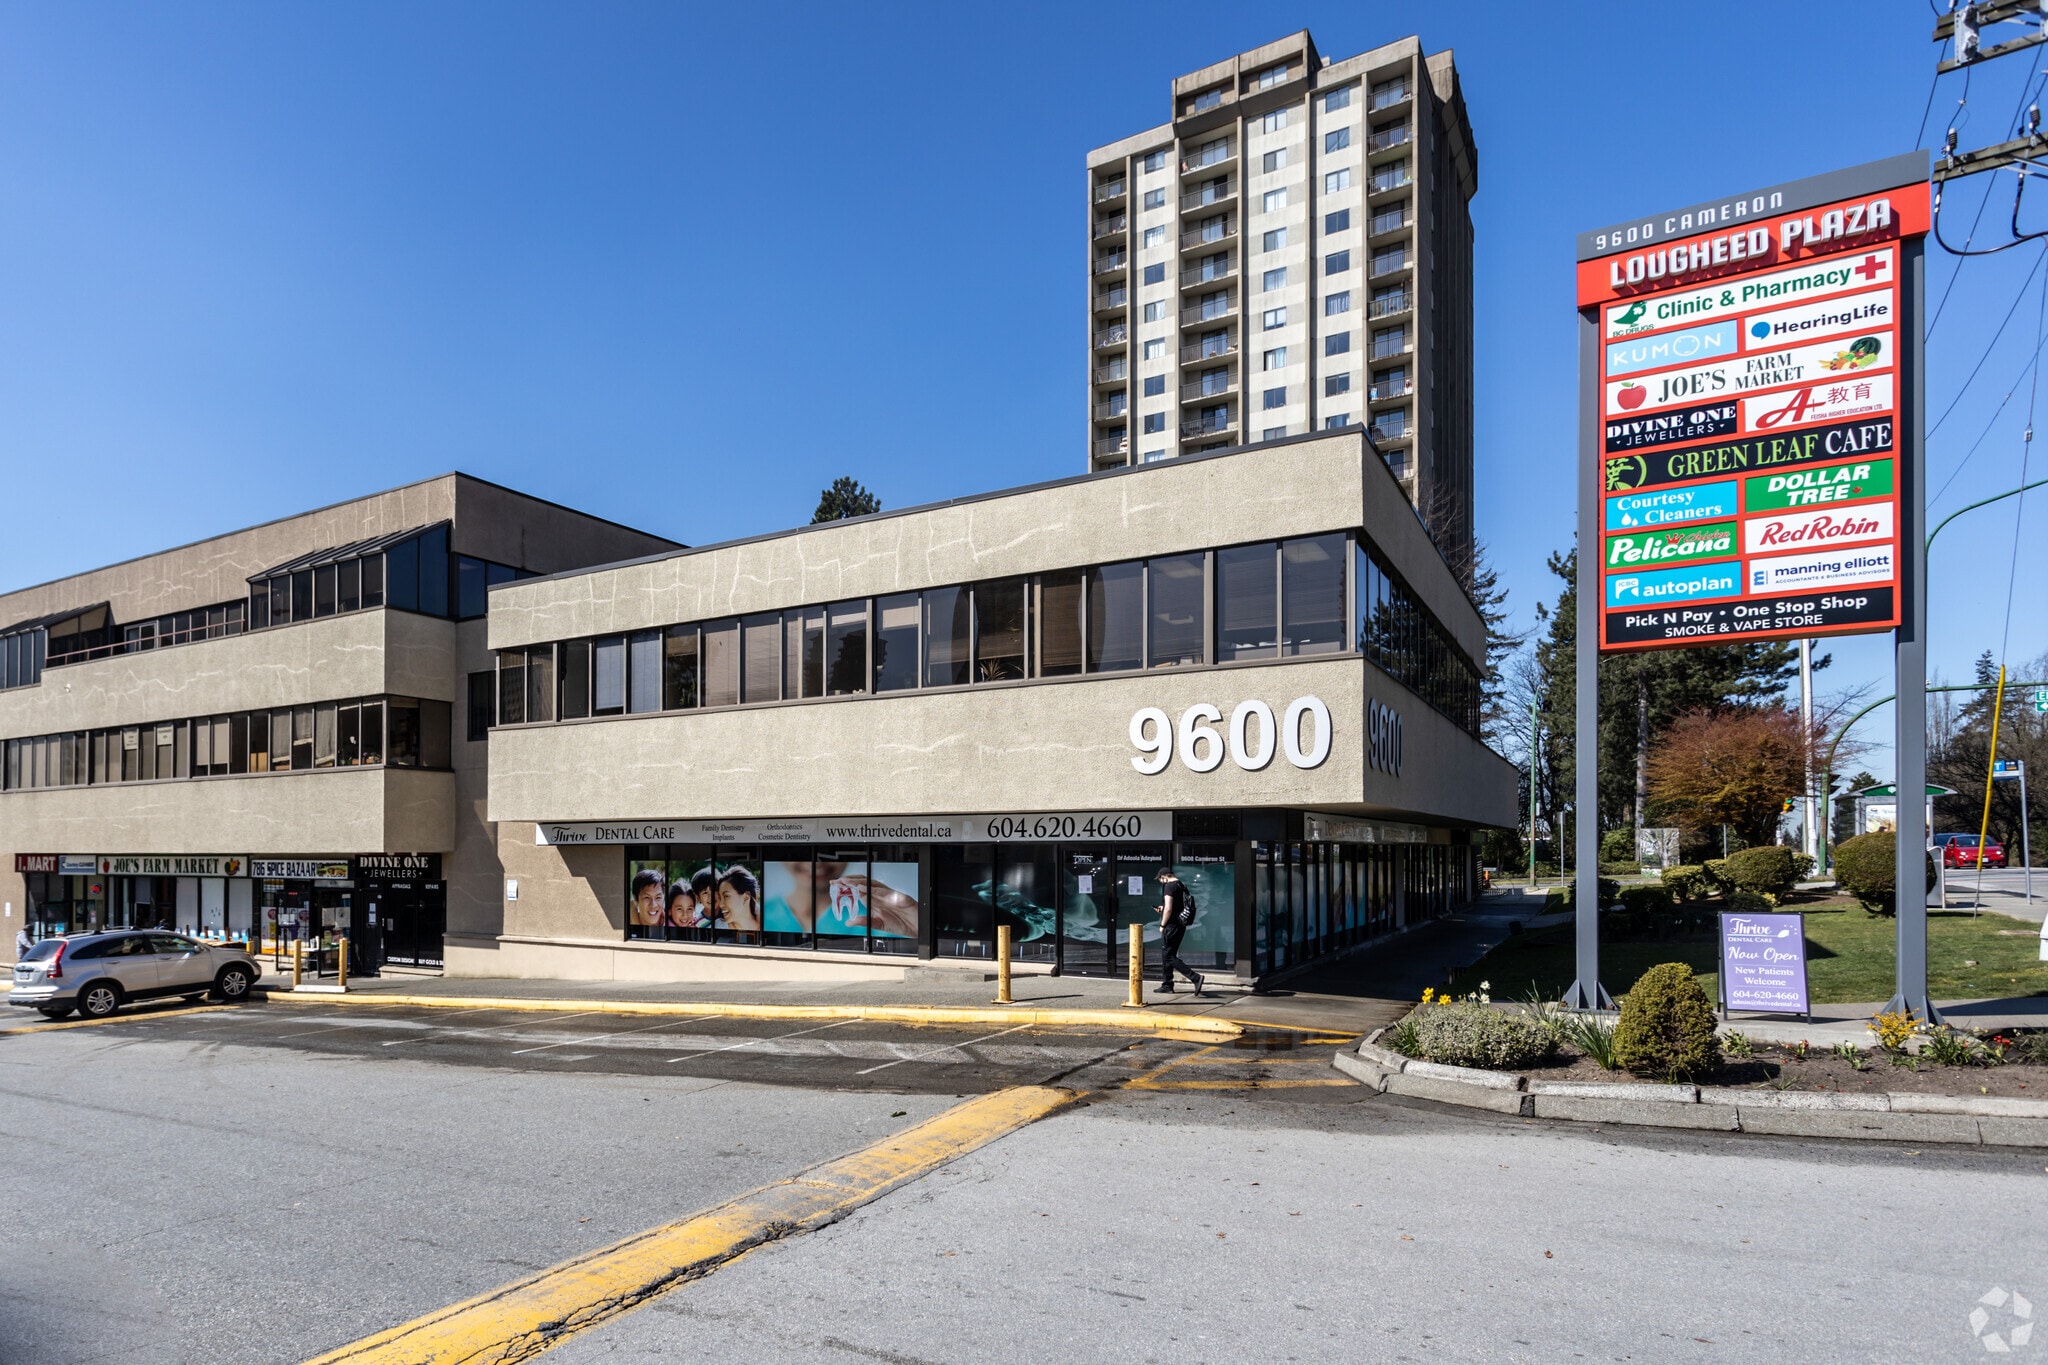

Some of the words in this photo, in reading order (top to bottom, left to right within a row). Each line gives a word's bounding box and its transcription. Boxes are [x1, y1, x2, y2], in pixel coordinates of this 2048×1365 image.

[1595, 222, 1654, 251] 9600
[1665, 191, 1783, 235] CAMERON
[1610, 227, 1769, 289] LOUGHEED
[1780, 198, 1891, 252] PLAZA
[1657, 296, 1713, 320] Clinic
[1720, 290, 1735, 307] &
[1742, 266, 1852, 303] Pharmacy
[1773, 303, 1889, 336] HearingLife
[1613, 329, 1625, 337] BC
[1625, 323, 1655, 335] DRUGS
[1613, 332, 1722, 367] KUMON
[1746, 352, 1793, 374] FARM
[1658, 369, 1727, 402] JOE'S
[1735, 366, 1805, 391] MARKET
[1827, 382, 1873, 405] 教育
[1846, 405, 1873, 415] EDUCATION
[1606, 414, 1684, 439] DIVINE
[1689, 406, 1737, 425] ONE
[1626, 423, 1715, 446] JEWELLERS
[1667, 445, 1750, 478] GREEN
[1756, 434, 1819, 466] LEAF
[1825, 423, 1893, 455] CAFE
[1767, 465, 1871, 493] DOLLAR
[1617, 491, 1696, 511] Courtesy
[1786, 484, 1849, 507] TREE
[1644, 504, 1722, 524] Cleaners
[1684, 529, 1731, 543] Chicken
[1609, 536, 1731, 565] Pelicana
[1774, 561, 1841, 577] manning
[1844, 554, 1890, 569] elliott
[1775, 575, 1819, 584] ACCOUNTANTS
[1826, 571, 1857, 579] BUSINESS
[1858, 568, 1890, 576] ADVISORS
[1643, 577, 1733, 597] autoplan
[1625, 615, 1658, 628] Pick
[1663, 613, 1677, 625] N
[1683, 609, 1713, 627] Pay
[1733, 604, 1773, 619] One
[1776, 601, 1815, 618] Stop
[1820, 595, 1868, 610] Shop
[1665, 624, 1716, 638] SMOKE
[1718, 623, 1730, 633] &
[1733, 619, 1770, 633] VAPE
[1775, 614, 1823, 628] STORE
[1128, 695, 1332, 776] 9600
[1368, 697, 1402, 778] 9600
[552, 826, 589, 843] Thrive
[595, 826, 640, 840] DENTAL
[643, 825, 675, 840] CARE
[701, 824, 720, 833] Family
[721, 823, 745, 833] Dentistry
[766, 822, 803, 831] Orthodontics
[826, 823, 952, 839] www.thrivedental.ca
[987, 815, 1142, 839] 604.620.4660
[712, 833, 735, 842] Implants
[757, 832, 784, 841] Cosmetic
[785, 832, 811, 842] Dentistry
[113, 858, 140, 873] JOE'S
[143, 858, 170, 873] FARM
[174, 858, 219, 874] MARKET
[252, 862, 265, 876] 786
[266, 862, 284, 876] SPICE
[286, 862, 317, 877] BAZAAR
[360, 856, 401, 868] DIVINE
[403, 856, 428, 868] ONE
[369, 869, 417, 879] JEWELLERS
[1729, 917, 1772, 935] Thrive
[1728, 946, 1759, 960] Now
[1763, 947, 1799, 963] Open
[1735, 966, 1756, 975] New
[1758, 967, 1795, 976] Patients
[1744, 977, 1787, 986] Welcome
[1733, 990, 1799, 1000] 604-620-4660
